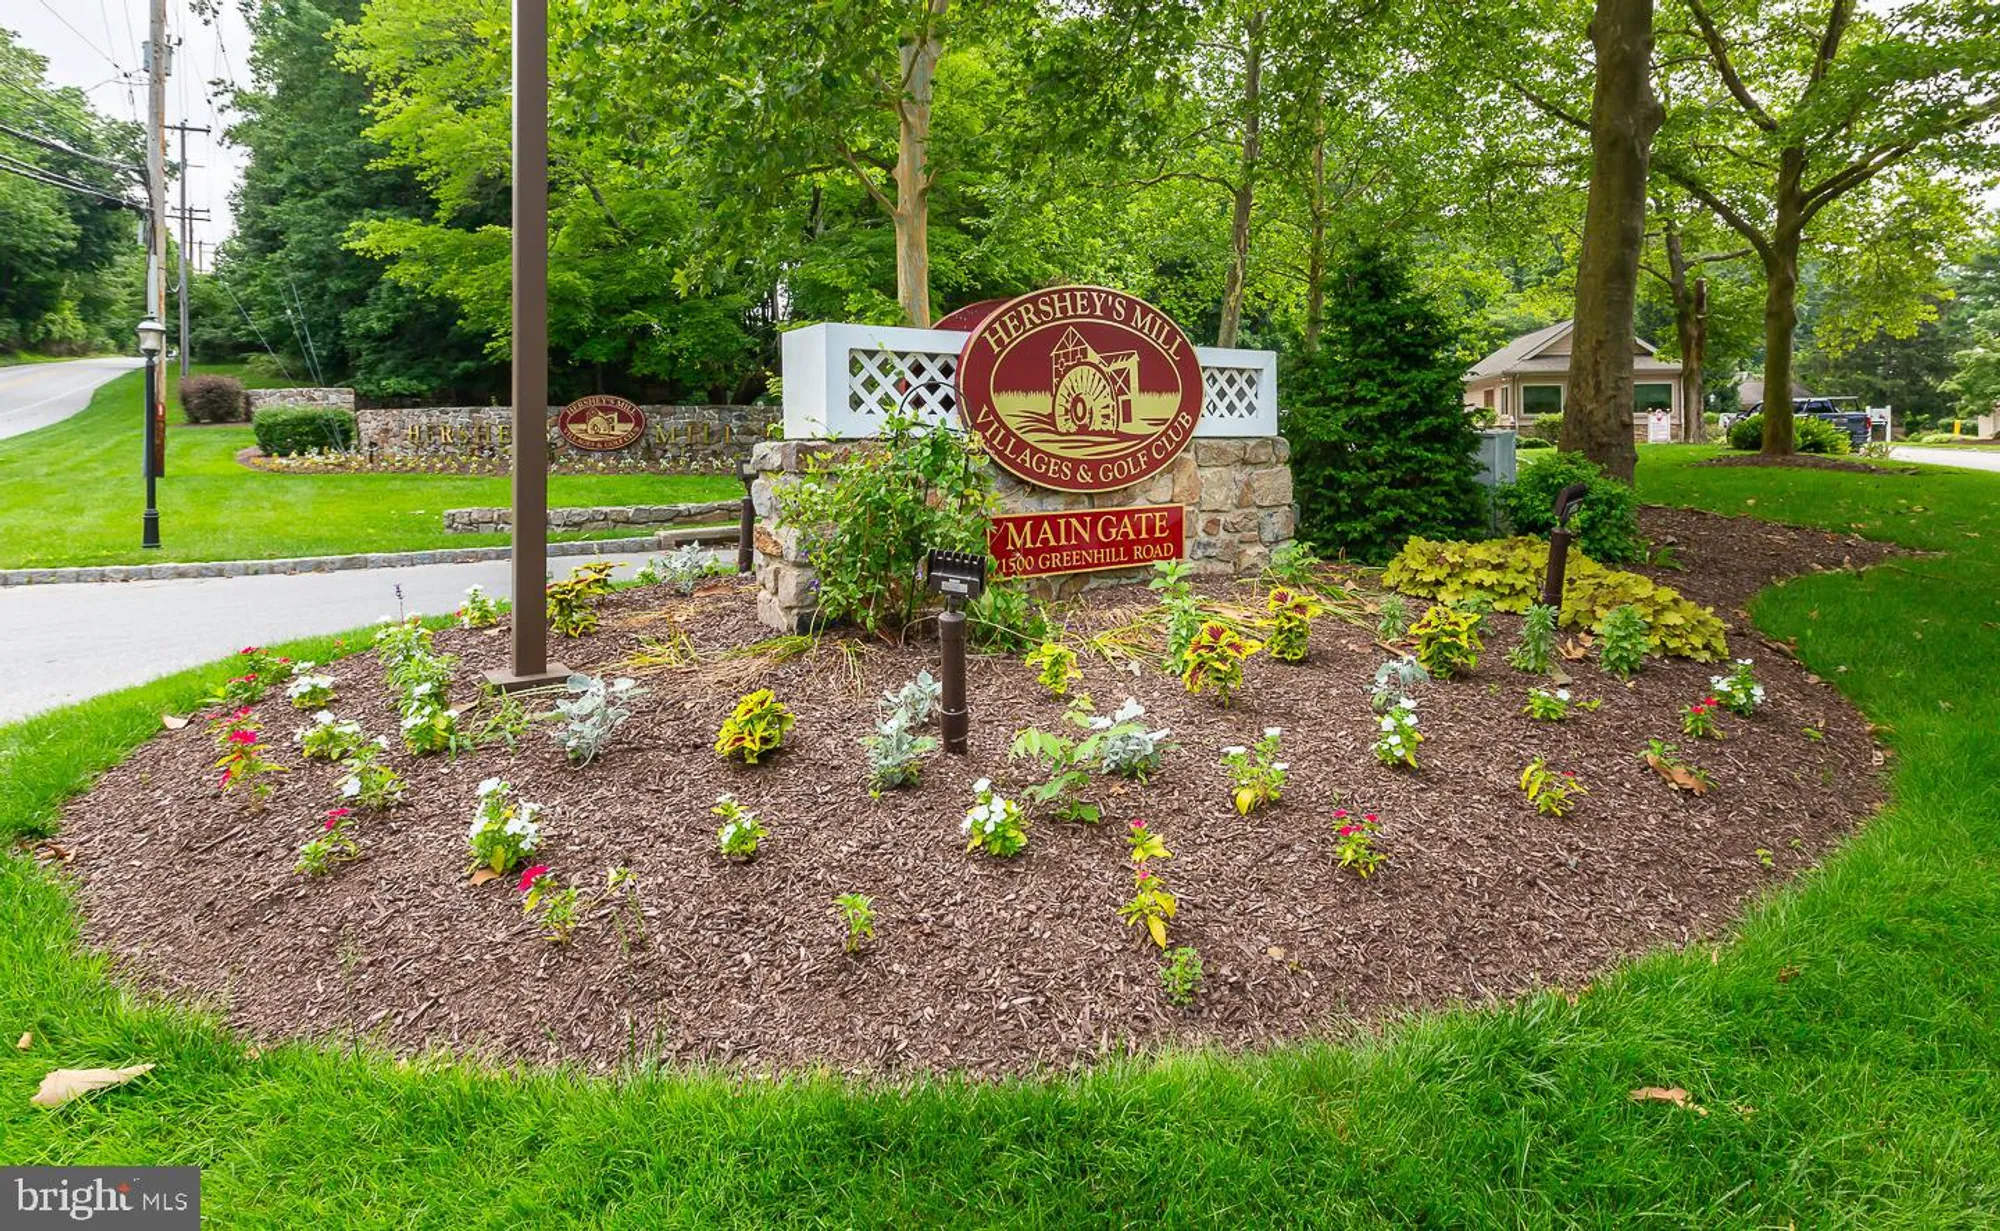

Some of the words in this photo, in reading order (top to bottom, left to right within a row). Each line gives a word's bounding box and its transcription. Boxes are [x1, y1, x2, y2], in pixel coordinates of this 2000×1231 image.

[981, 291, 1127, 355] HERSHEY'S
[1130, 305, 1184, 361] MILL
[975, 404, 1073, 481] VILLAGES
[1076, 464, 1094, 484] &
[1099, 452, 1149, 483] GOLF
[1152, 411, 1194, 461] CLUB
[1002, 554, 1035, 573] 1500
[1038, 546, 1129, 570] GREENHILL
[1133, 542, 1174, 560] ROAD
[1005, 515, 1092, 550] MAIN
[1097, 511, 1170, 542] GATE
